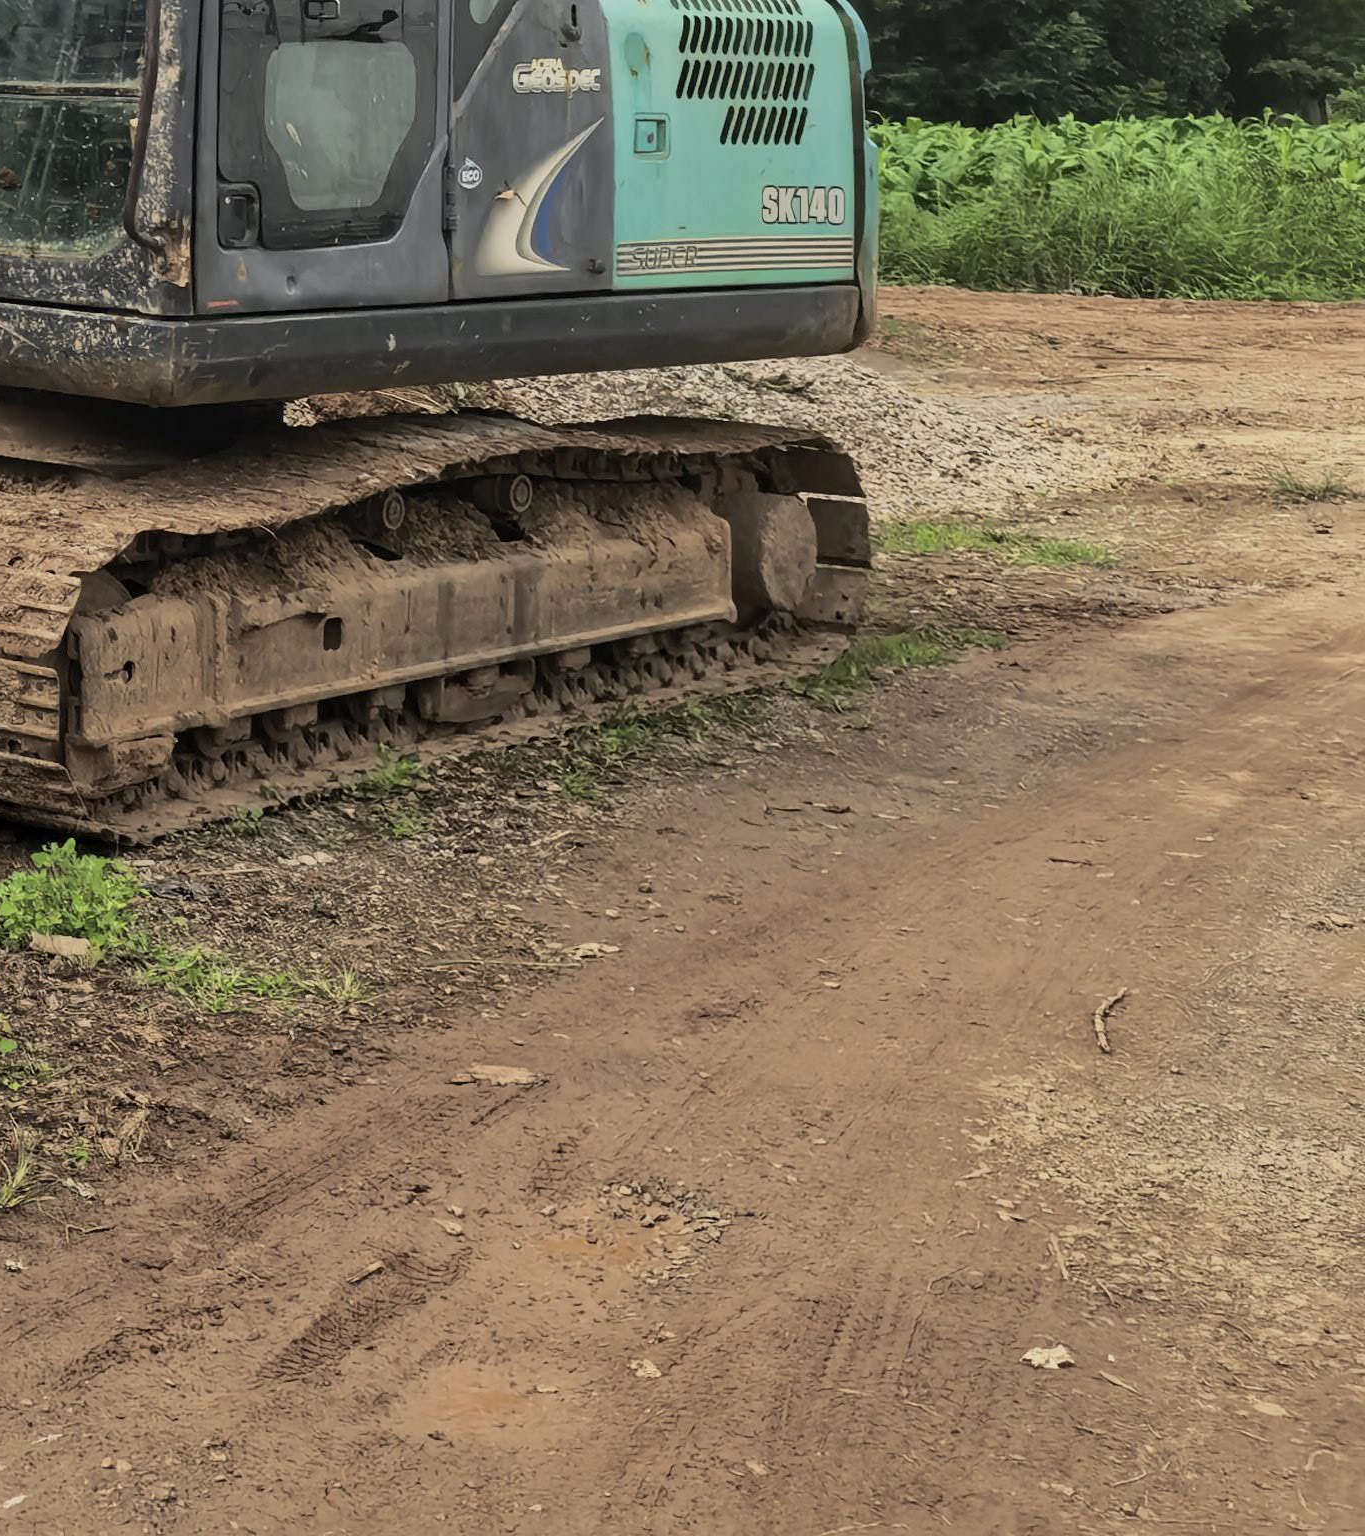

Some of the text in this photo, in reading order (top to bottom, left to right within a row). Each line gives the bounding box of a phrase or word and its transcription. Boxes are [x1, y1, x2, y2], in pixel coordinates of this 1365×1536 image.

[462, 169, 479, 182] ECO
[762, 185, 845, 225] SK140
[631, 245, 699, 270] SUPER
